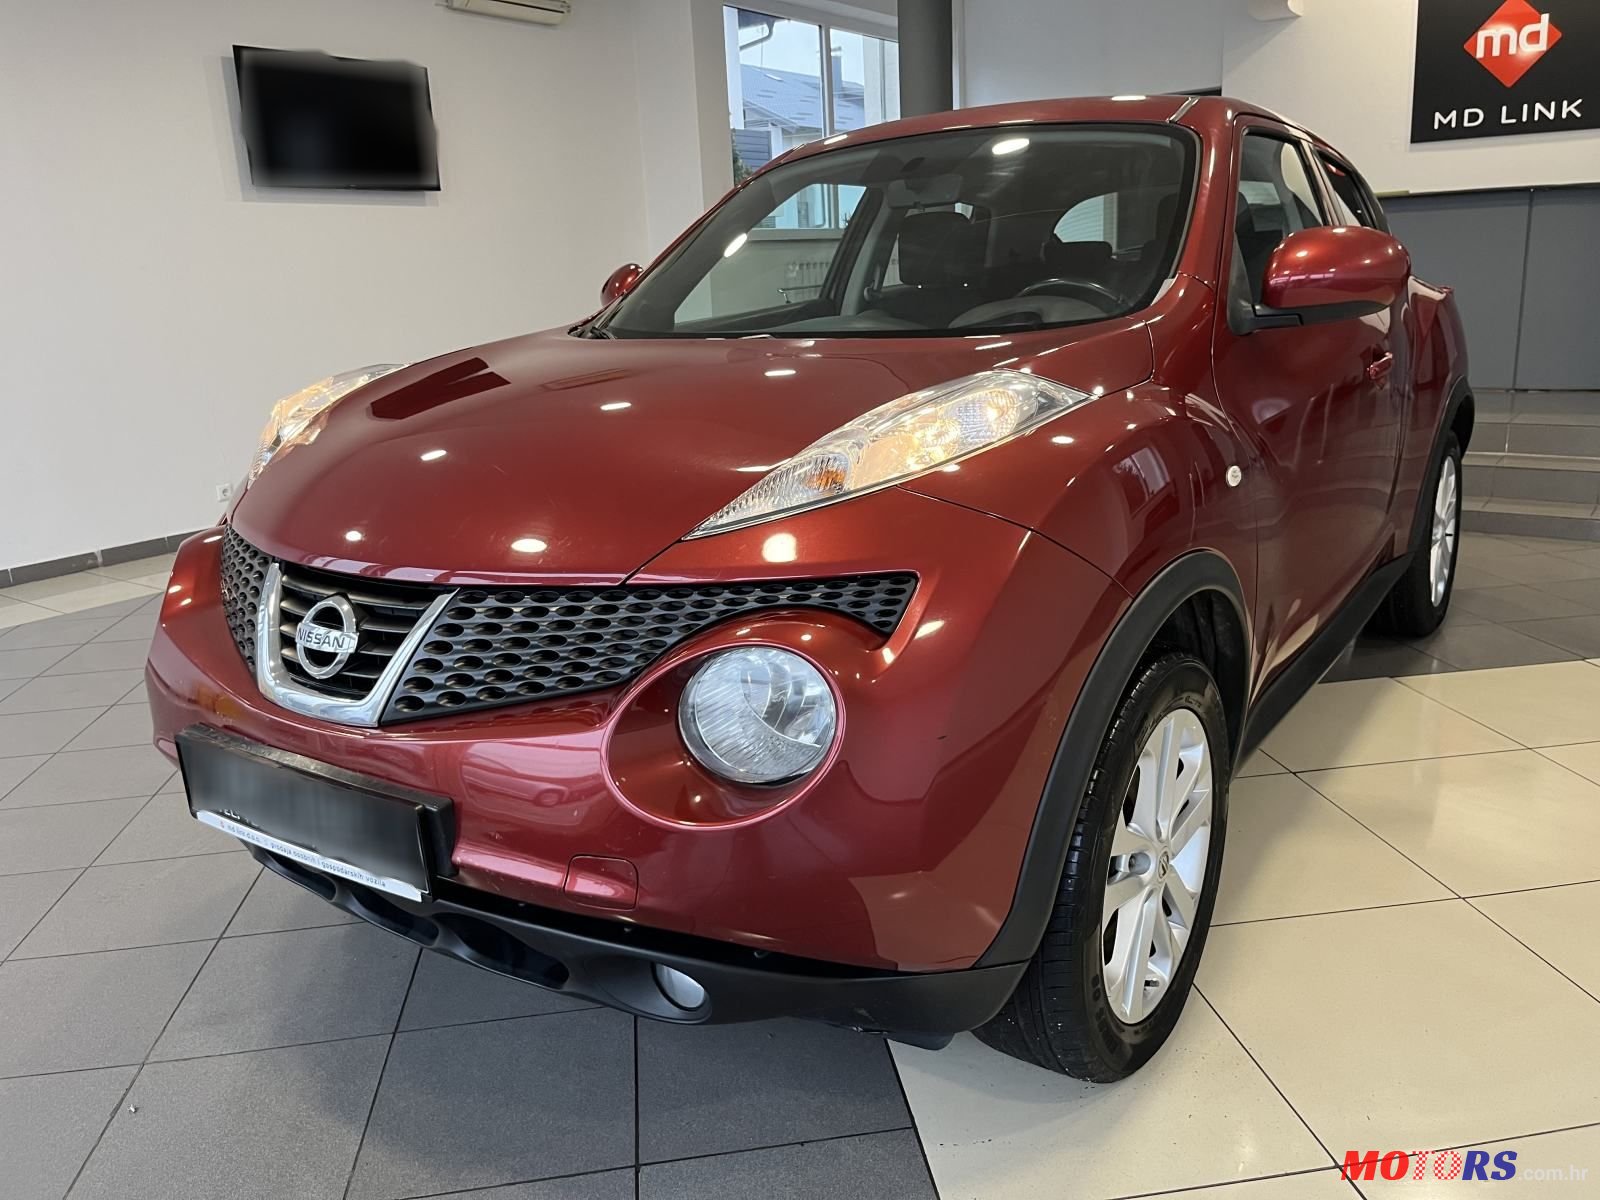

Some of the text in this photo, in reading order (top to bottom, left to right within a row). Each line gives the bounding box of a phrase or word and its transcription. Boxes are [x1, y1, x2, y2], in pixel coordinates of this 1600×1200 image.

[1475, 13, 1550, 58] md
[1433, 98, 1583, 130] MD LINK
[298, 627, 345, 648] NISSAN
[365, 876, 386, 887] vozila
